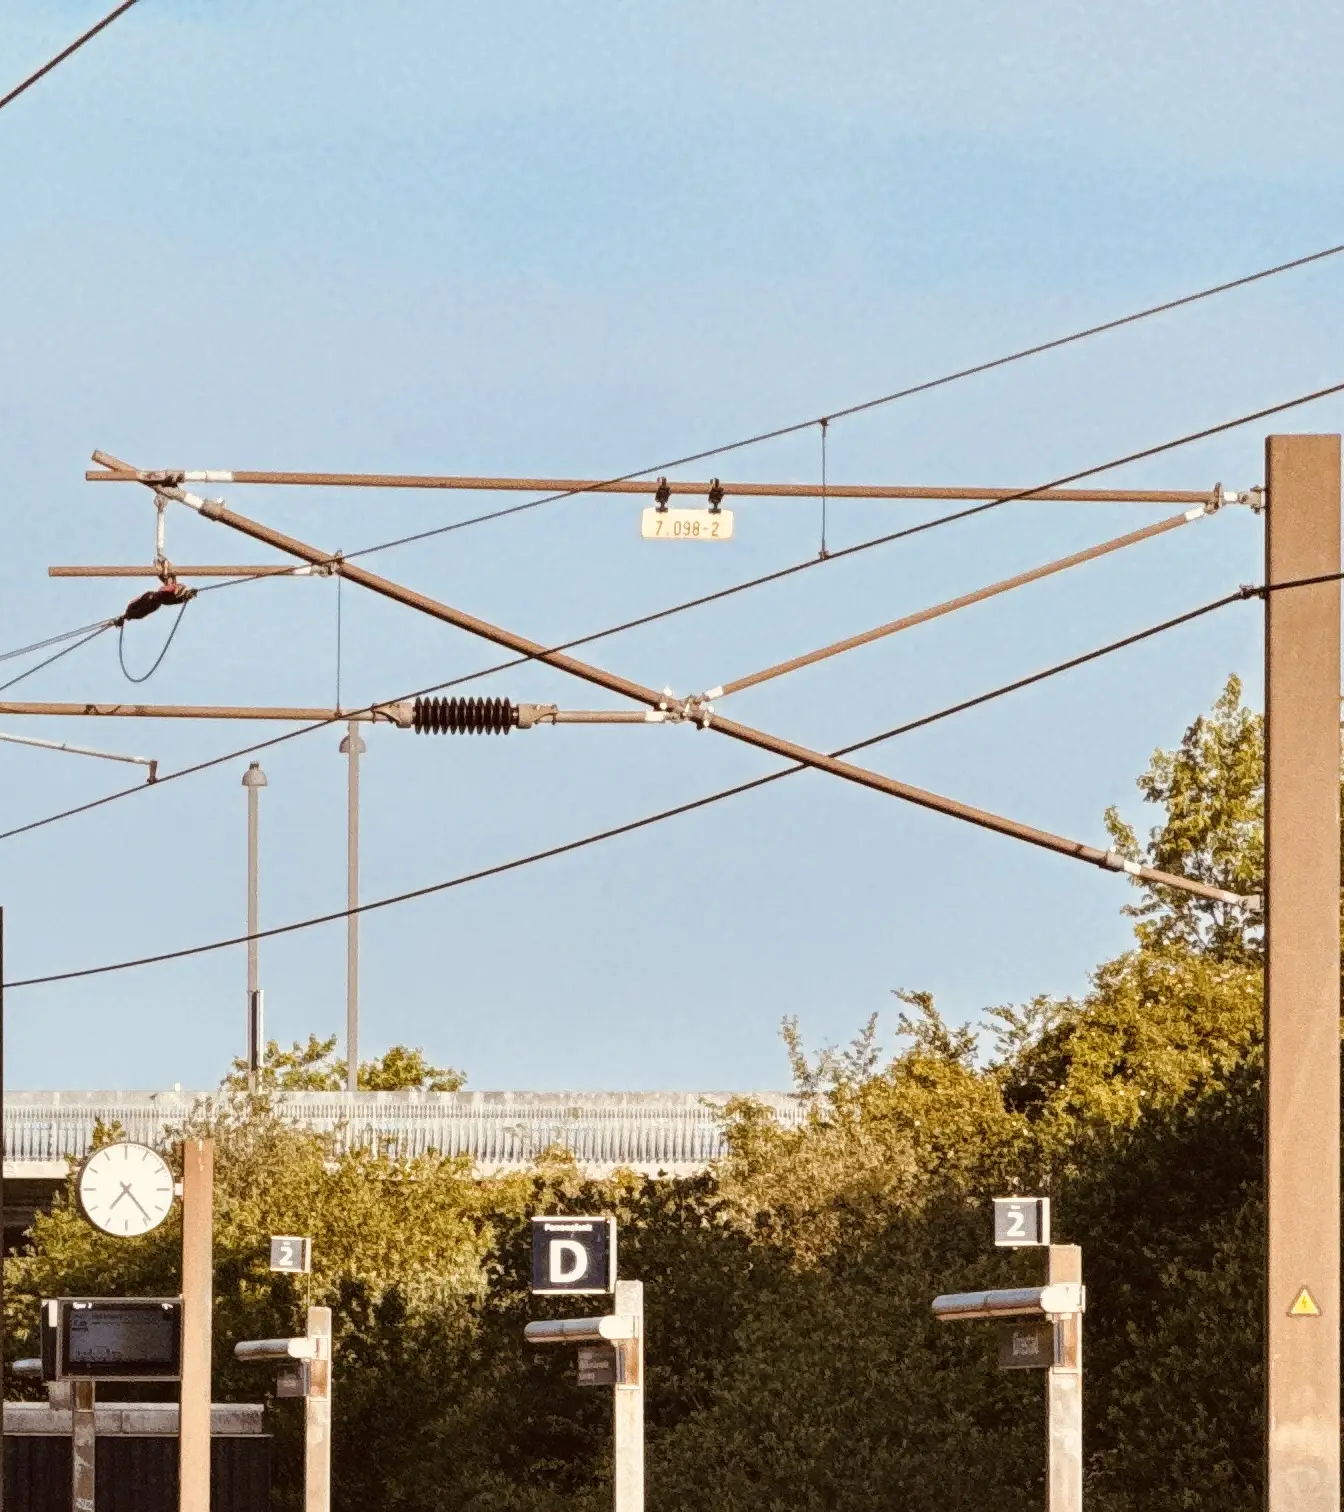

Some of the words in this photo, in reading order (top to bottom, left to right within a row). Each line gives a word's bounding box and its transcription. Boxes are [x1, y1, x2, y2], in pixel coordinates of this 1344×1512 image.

[1006, 1211, 1026, 1237] 2
[279, 1246, 293, 1266] 2
[550, 1240, 588, 1283] D
